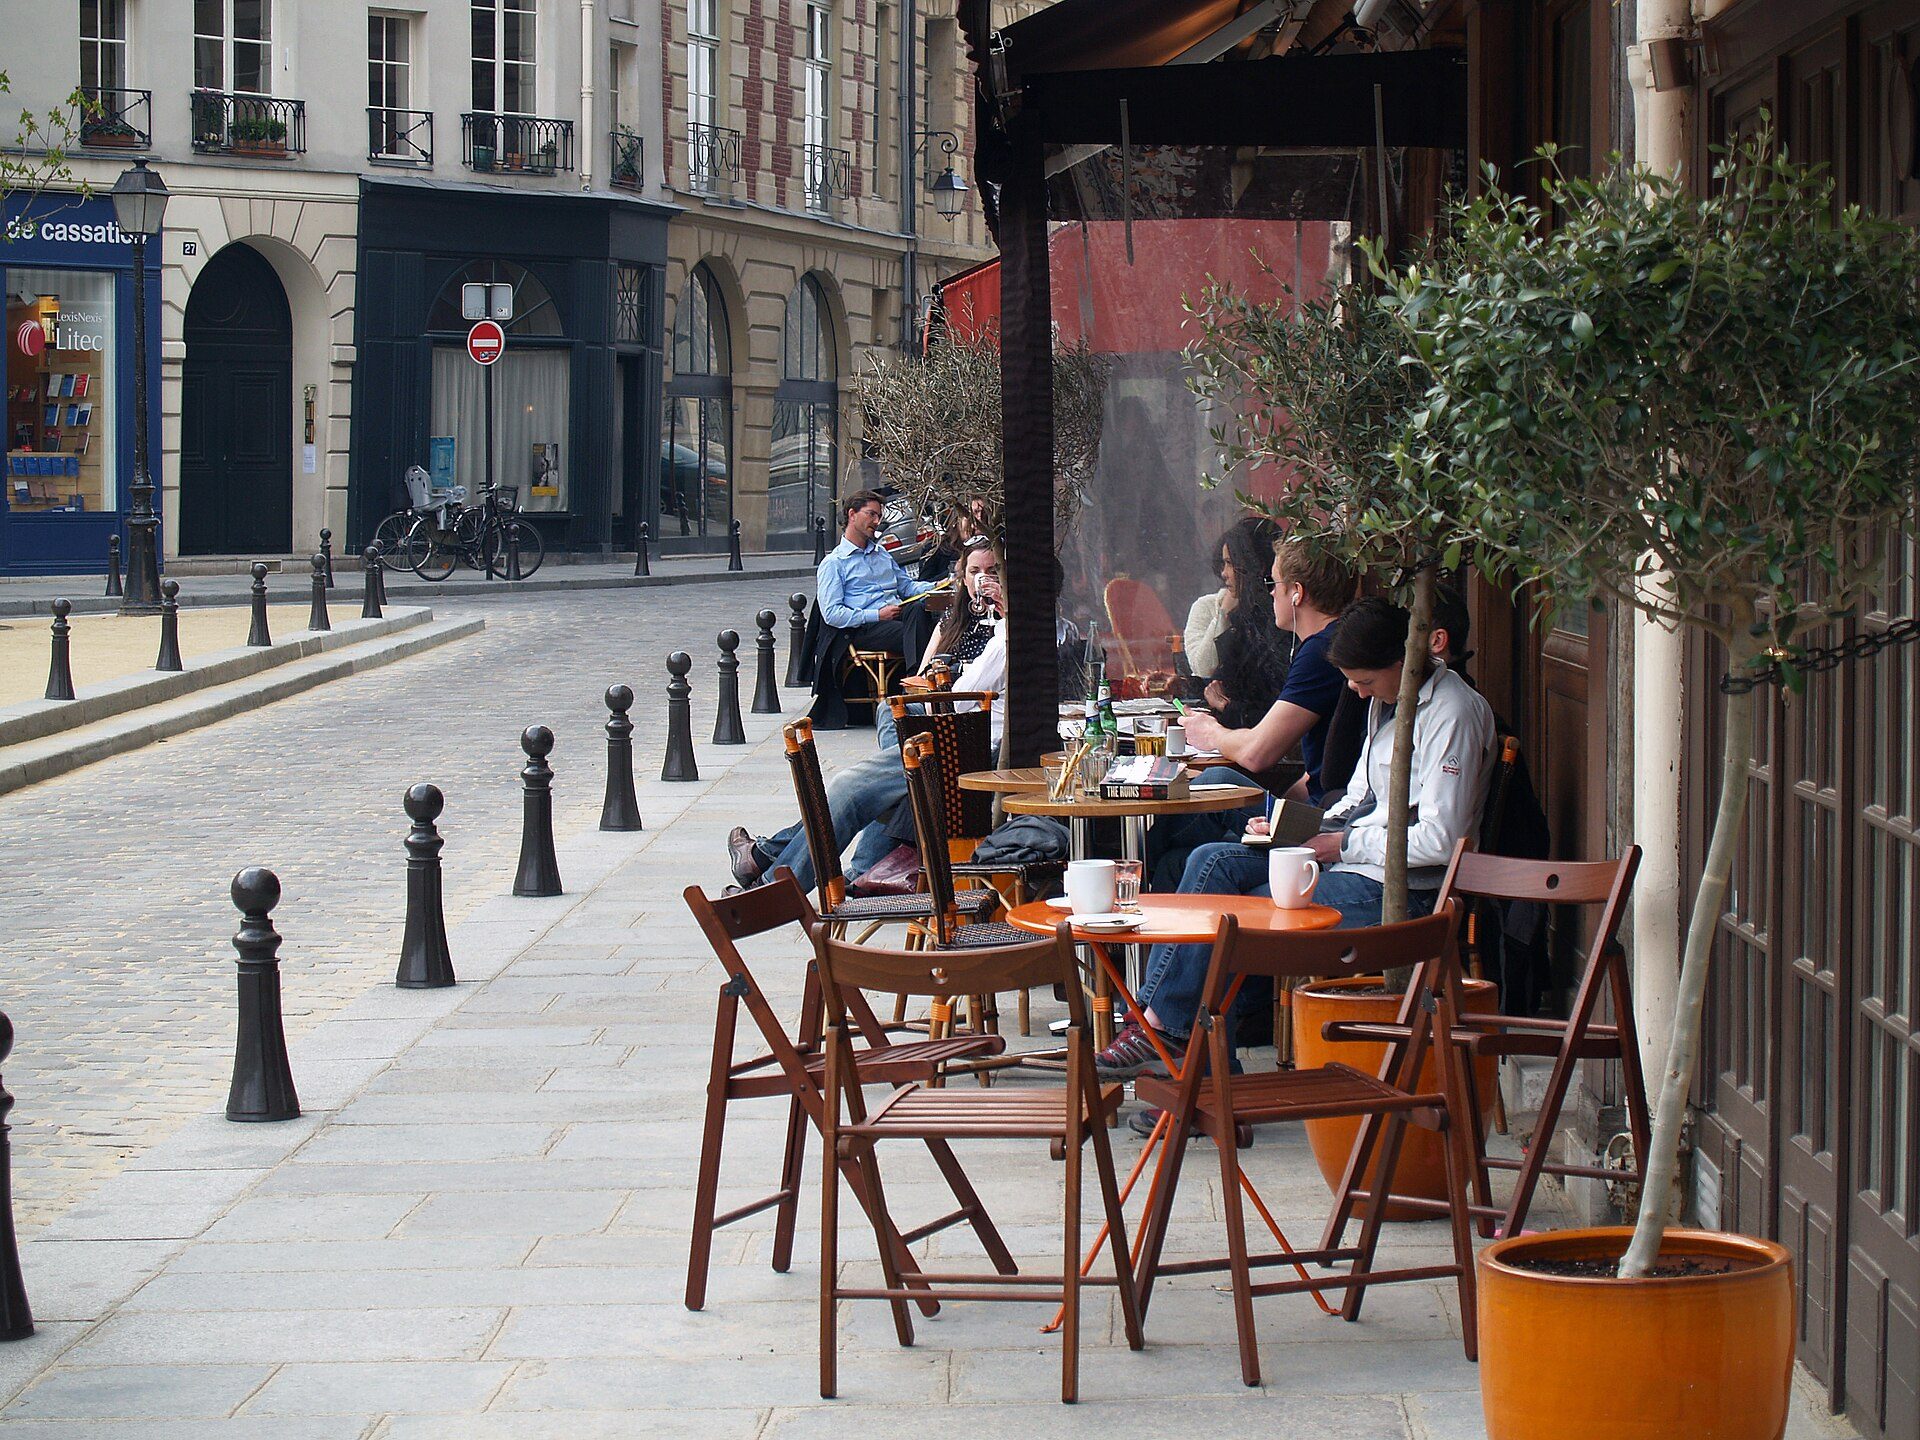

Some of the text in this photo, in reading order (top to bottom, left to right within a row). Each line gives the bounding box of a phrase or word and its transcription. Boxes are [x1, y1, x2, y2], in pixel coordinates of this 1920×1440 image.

[6, 216, 34, 240] de
[184, 243, 196, 254] 27
[56, 311, 103, 323] LexisNexis
[56, 327, 103, 352] Litec
[1106, 785, 1119, 798] THE
[1120, 785, 1140, 798] RUINS
